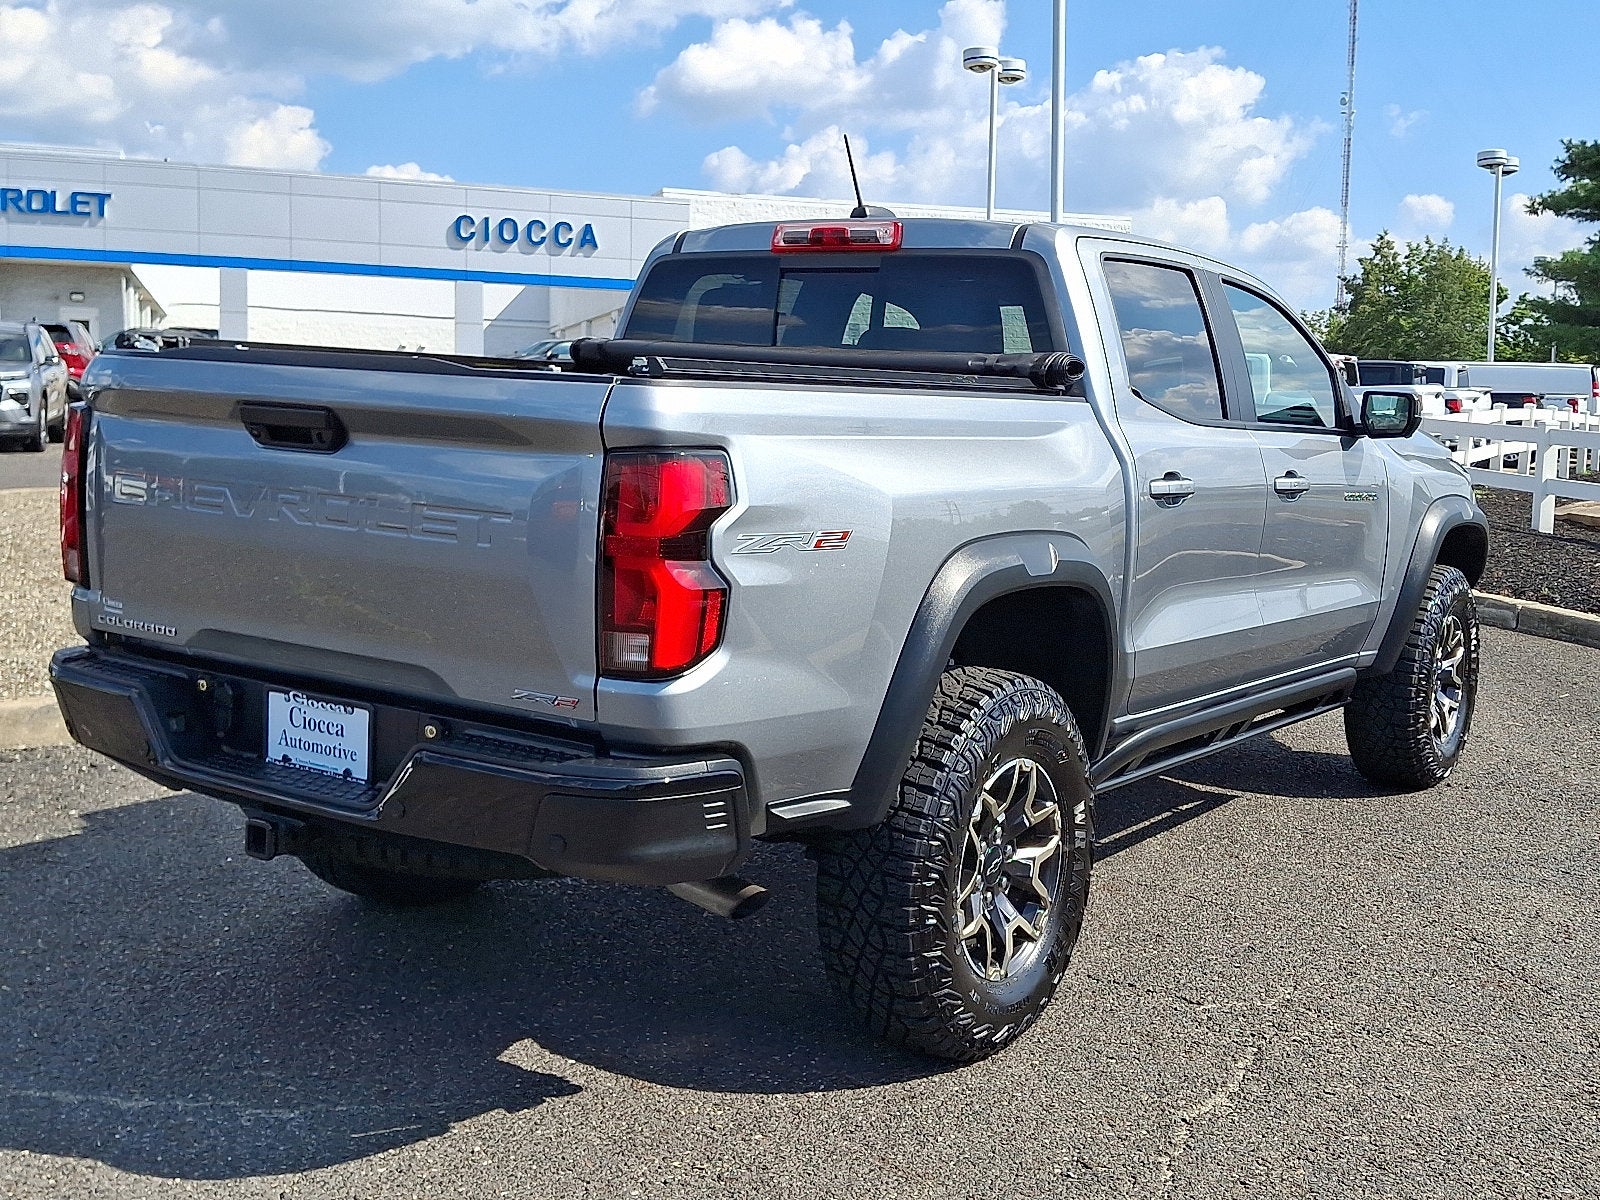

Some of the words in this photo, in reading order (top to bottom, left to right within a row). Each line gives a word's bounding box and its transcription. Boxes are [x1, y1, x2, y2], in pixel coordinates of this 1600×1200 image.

[0, 188, 111, 217] ROLET
[455, 214, 598, 248] CIOCCA
[104, 472, 513, 547] CHEVROLET
[731, 529, 854, 555] ZR2
[98, 615, 177, 637] COLORADO
[290, 691, 345, 714] Ciocca
[511, 688, 579, 709] ZR2
[289, 706, 345, 738] Ciocca
[278, 728, 358, 762] Automotive
[1043, 800, 1087, 975] WRANGLER
